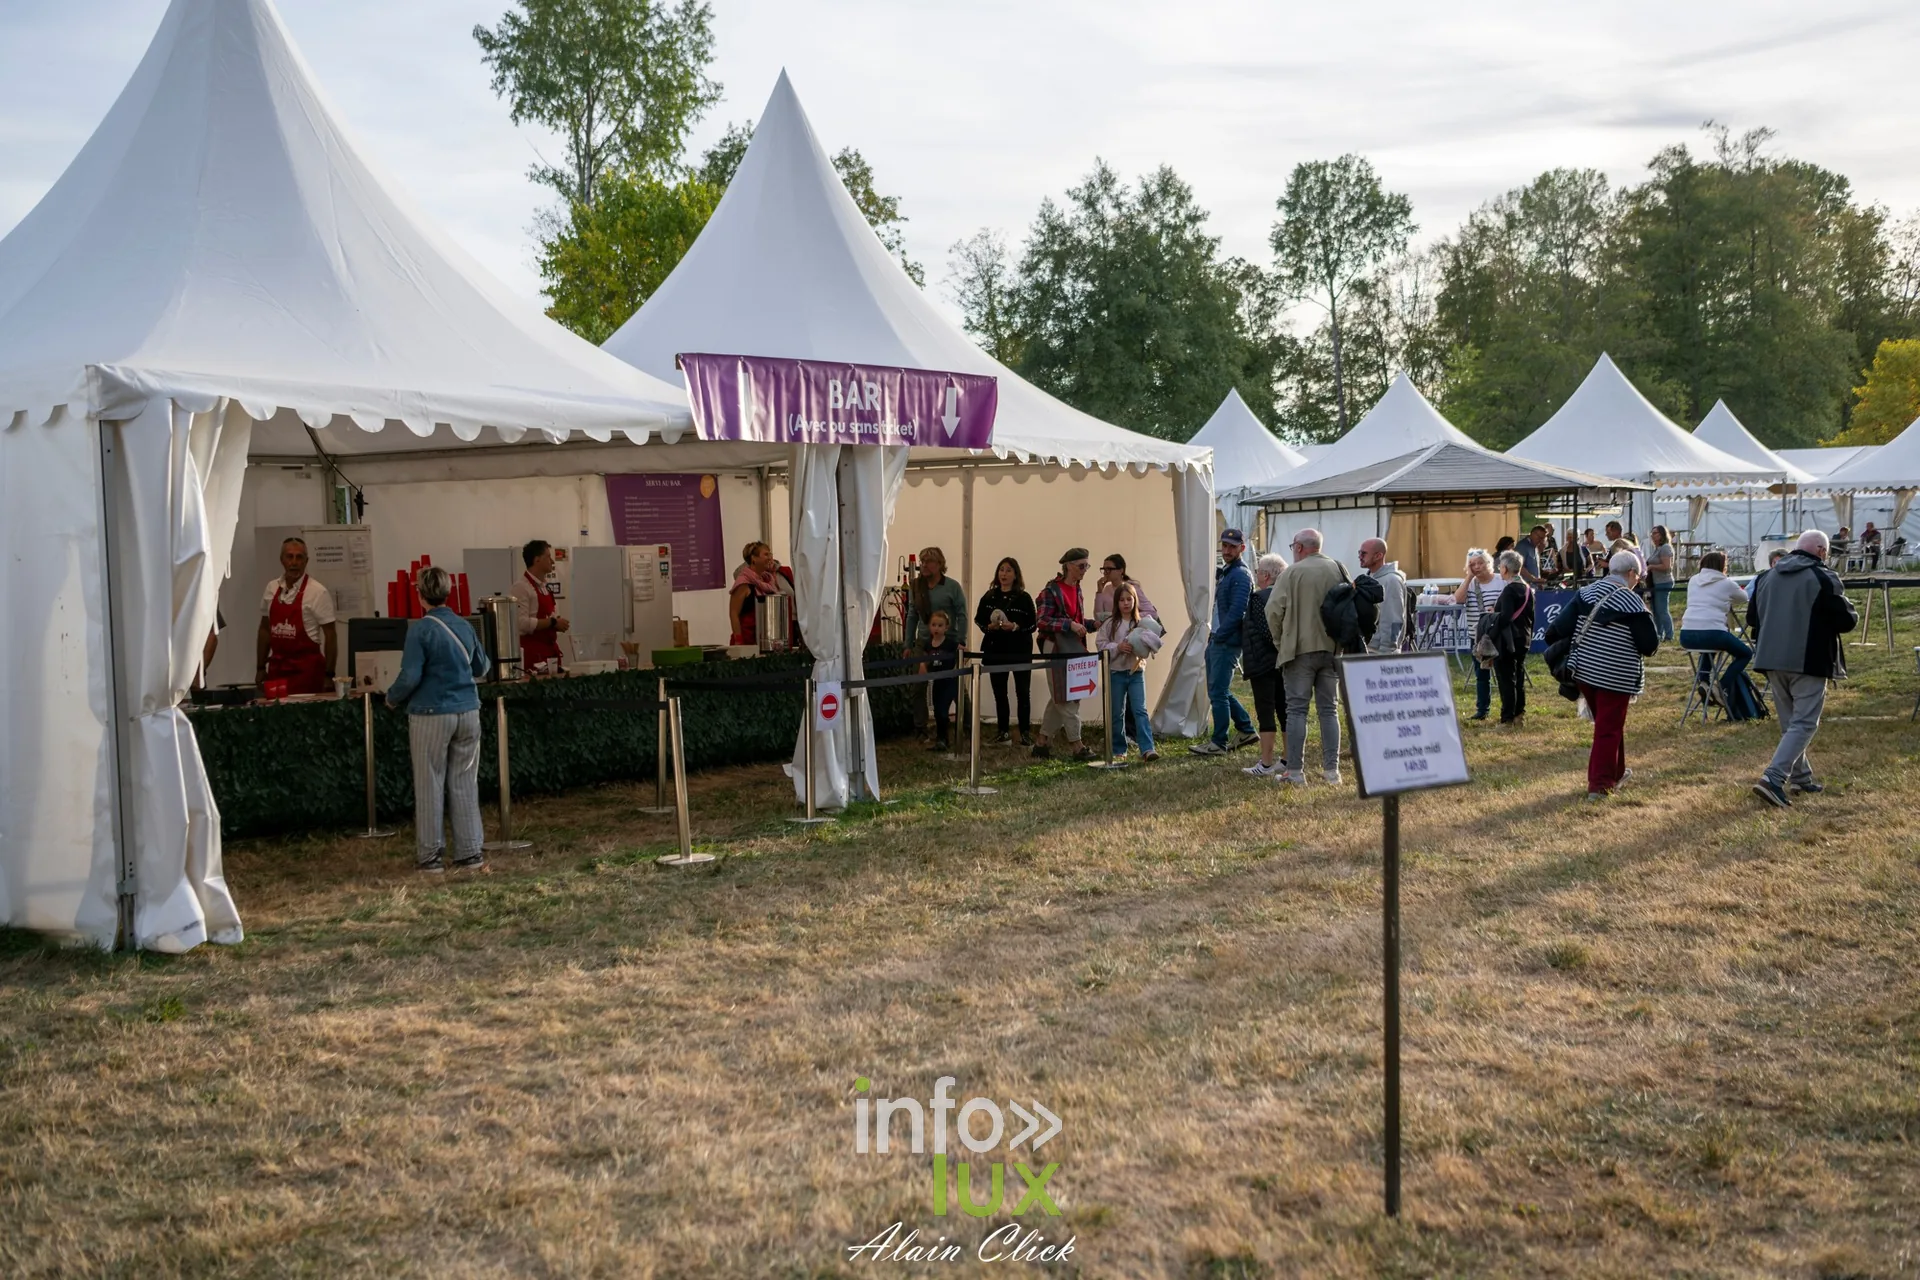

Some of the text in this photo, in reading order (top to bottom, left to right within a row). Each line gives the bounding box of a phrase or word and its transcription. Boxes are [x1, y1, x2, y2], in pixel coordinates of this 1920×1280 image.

[829, 380, 881, 411] BAR
[788, 413, 827, 436] (Avec
[830, 420, 846, 434] ou
[849, 420, 879, 434] sans
[1068, 660, 1086, 671] ENTRÉE
[1380, 664, 1414, 675] Horaires
[1365, 679, 1376, 690] fin
[1378, 678, 1389, 689] de
[1390, 676, 1416, 688] service
[1365, 689, 1439, 704] restauration rapide
[1358, 705, 1451, 725] vendredi et samedi soir
[1383, 742, 1441, 760] dimanche midi
